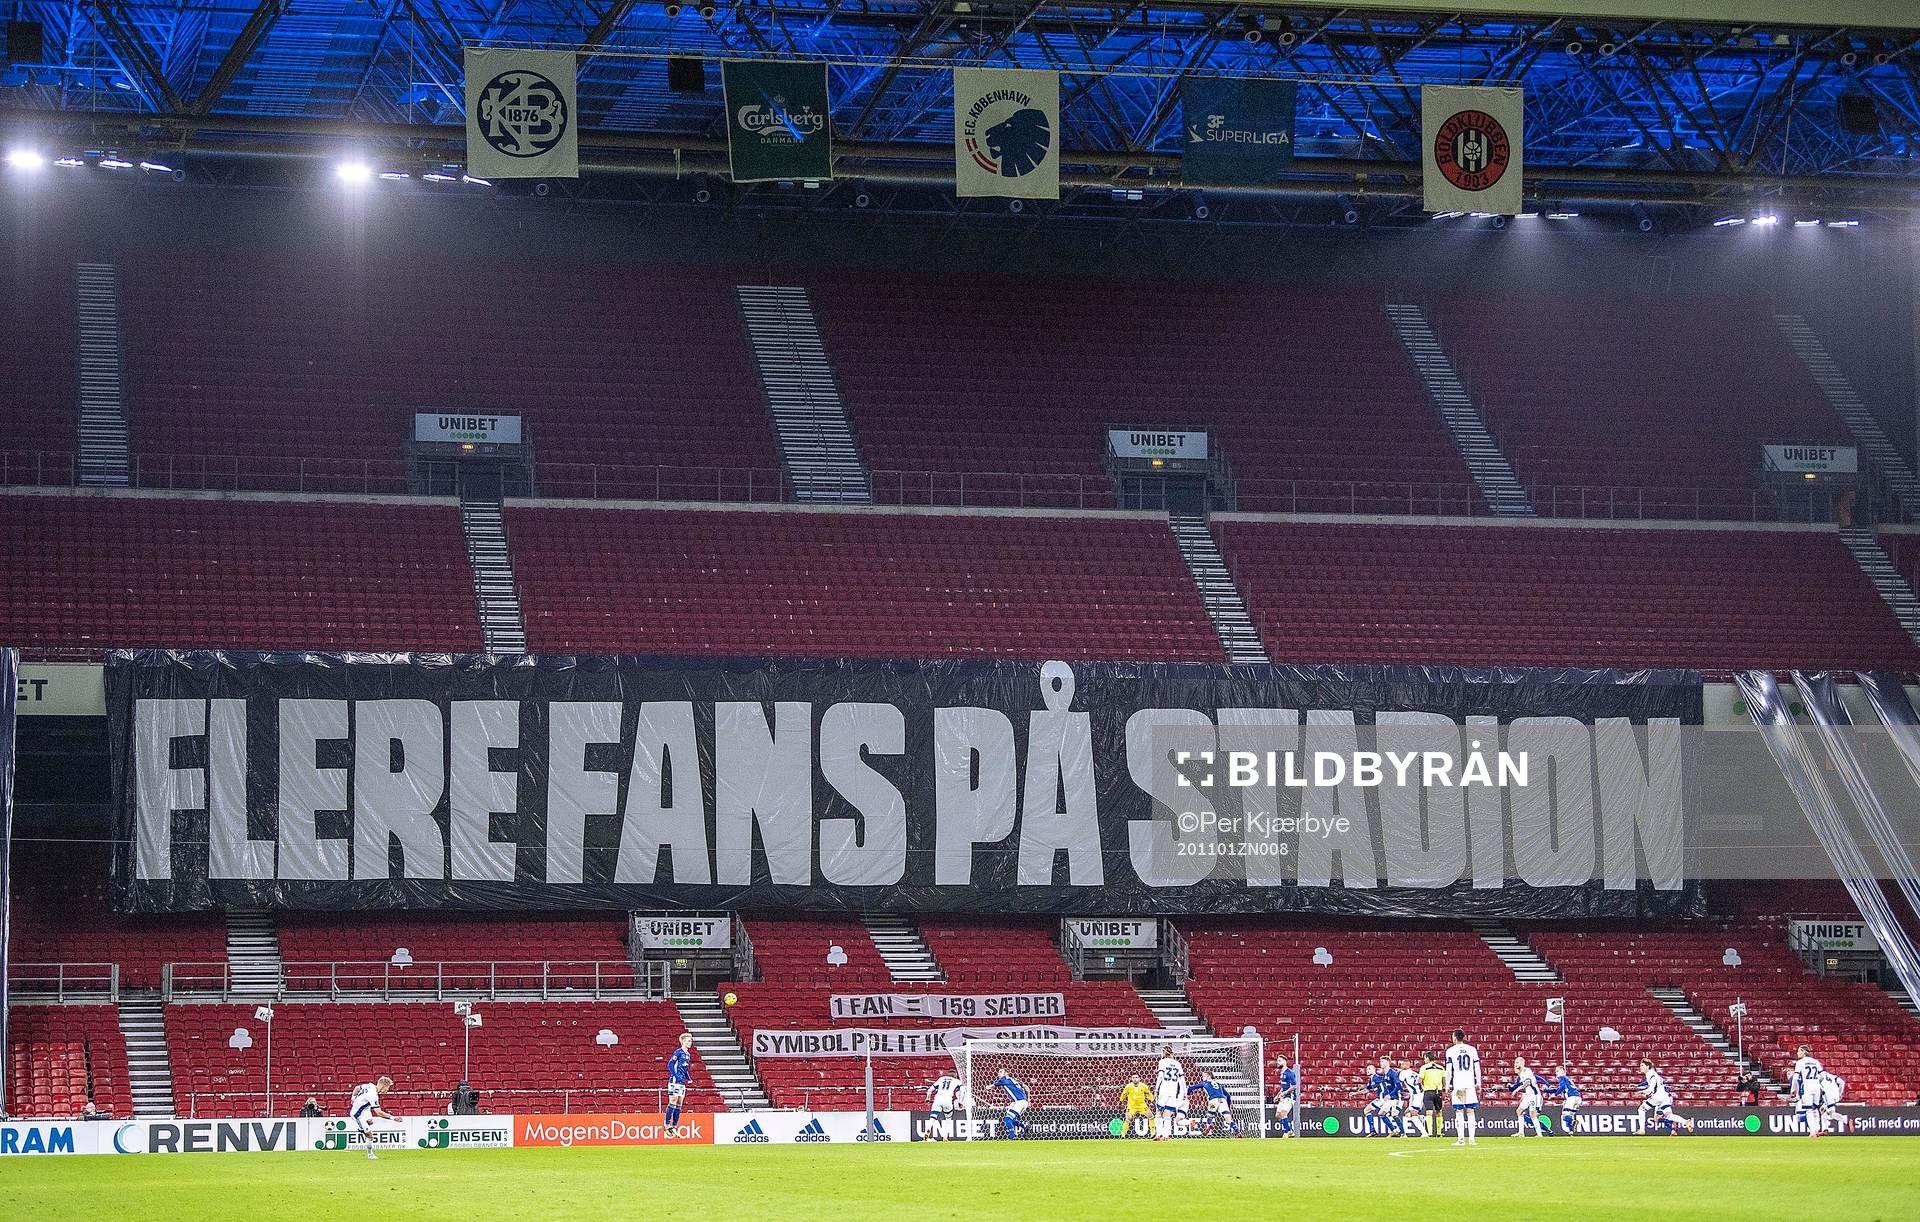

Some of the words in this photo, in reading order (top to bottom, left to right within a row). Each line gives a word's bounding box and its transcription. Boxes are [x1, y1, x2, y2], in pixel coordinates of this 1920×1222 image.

[508, 108, 540, 123] 1876
[737, 104, 824, 134] Carlsberg
[1207, 114, 1225, 129] 3F
[1206, 129, 1290, 144] SUPERLIGA
[1437, 112, 1508, 166] BOLDKLUBBEN
[1455, 171, 1489, 188] 1903
[438, 417, 499, 430] UNIBET
[1130, 434, 1186, 447] UNIBET
[1783, 448, 1836, 461] UNIBET
[135, 698, 520, 881] FLERE
[545, 700, 906, 886] FANS
[934, 660, 1105, 886] PÅ
[1125, 707, 1684, 891] STADION
[650, 922, 715, 936] UNIBET
[1080, 922, 1142, 936] UNIBET
[1805, 925, 1864, 938] UNIBET
[834, 999, 844, 1016] 1
[850, 997, 894, 1016] FAN
[939, 997, 976, 1017] 159
[985, 997, 1060, 1017] SÆDER
[1456, 1054, 1471, 1072] 10
[1163, 1067, 1179, 1082] 33
[1804, 1066, 1819, 1080] 22
[942, 1080, 952, 1091] 11
[1697, 1117, 1745, 1129] omtanke
[1855, 1117, 1876, 1131] Spil
[1882, 1118, 1900, 1129] med
[0, 1127, 75, 1154] RAM
[149, 1122, 297, 1153] RENVI
[734, 1133, 770, 1143] adidas
[795, 1132, 831, 1143] adidas
